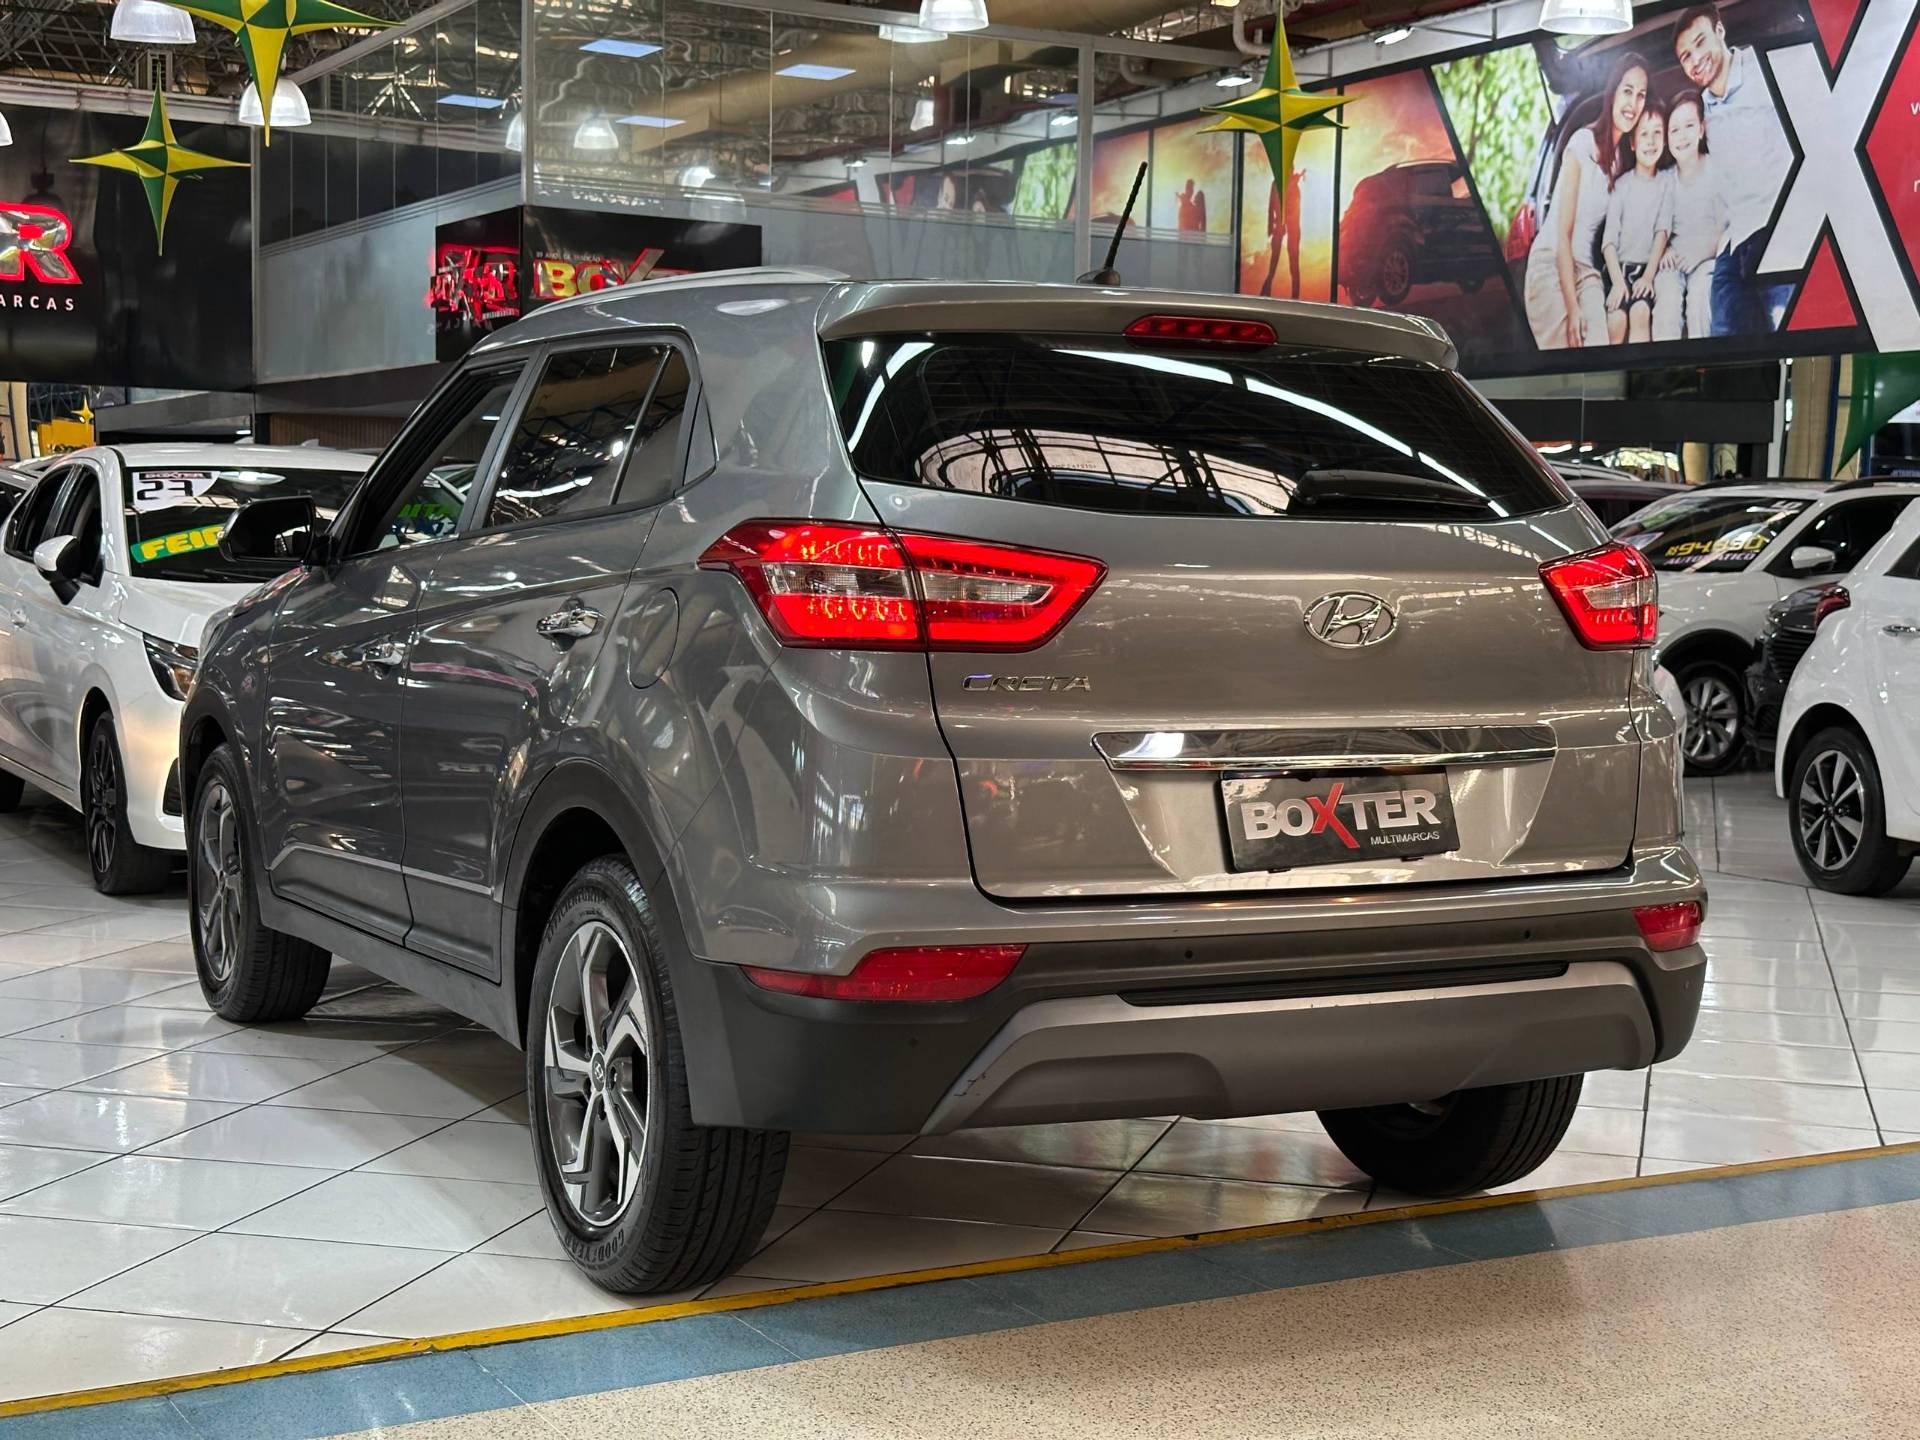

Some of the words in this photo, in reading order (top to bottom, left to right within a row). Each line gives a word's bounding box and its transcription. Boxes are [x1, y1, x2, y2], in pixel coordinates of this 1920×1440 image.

[962, 674, 1092, 692] CRETA
[1241, 783, 1441, 849] BOXTER
[1370, 831, 1440, 845] MULTIMARCAS
